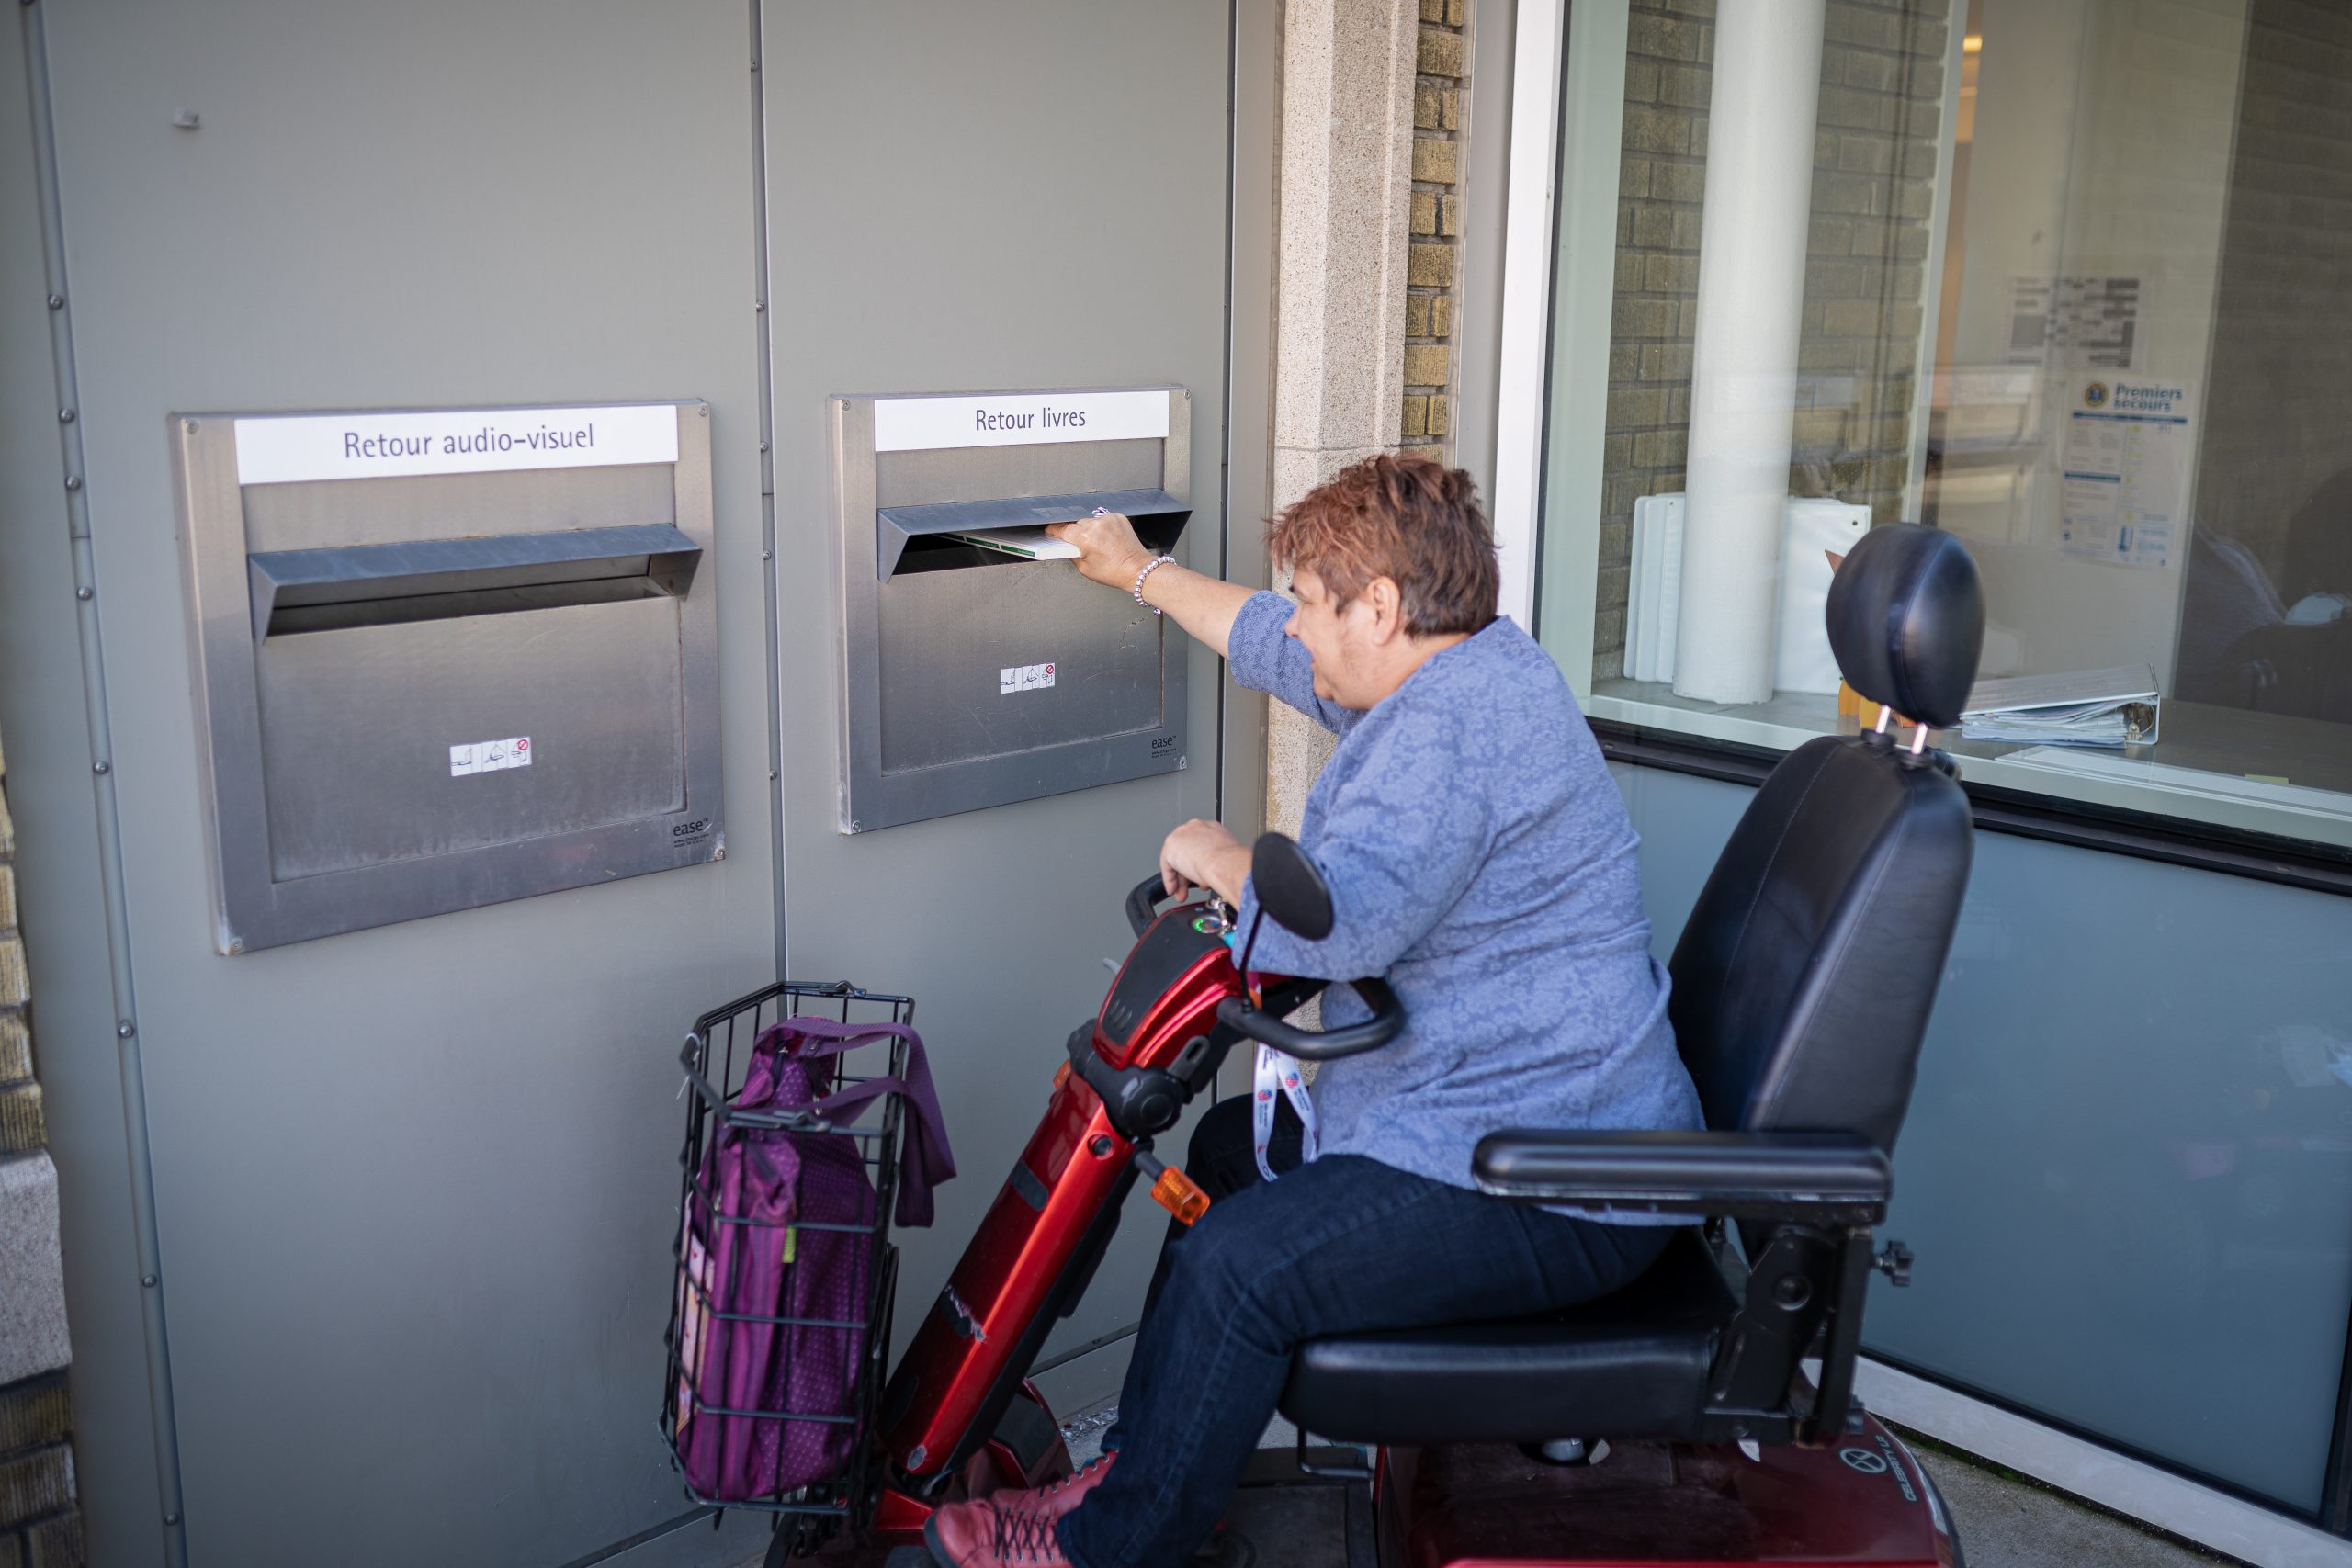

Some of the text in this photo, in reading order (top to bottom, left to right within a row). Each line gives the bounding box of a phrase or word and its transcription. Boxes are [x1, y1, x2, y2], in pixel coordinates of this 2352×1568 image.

[2116, 382, 2183, 400] Premiers
[976, 407, 1086, 431] Retour livres
[345, 423, 594, 458] Retour audio-visuel
[1882, 1449, 1917, 1501] CELEBRITY
